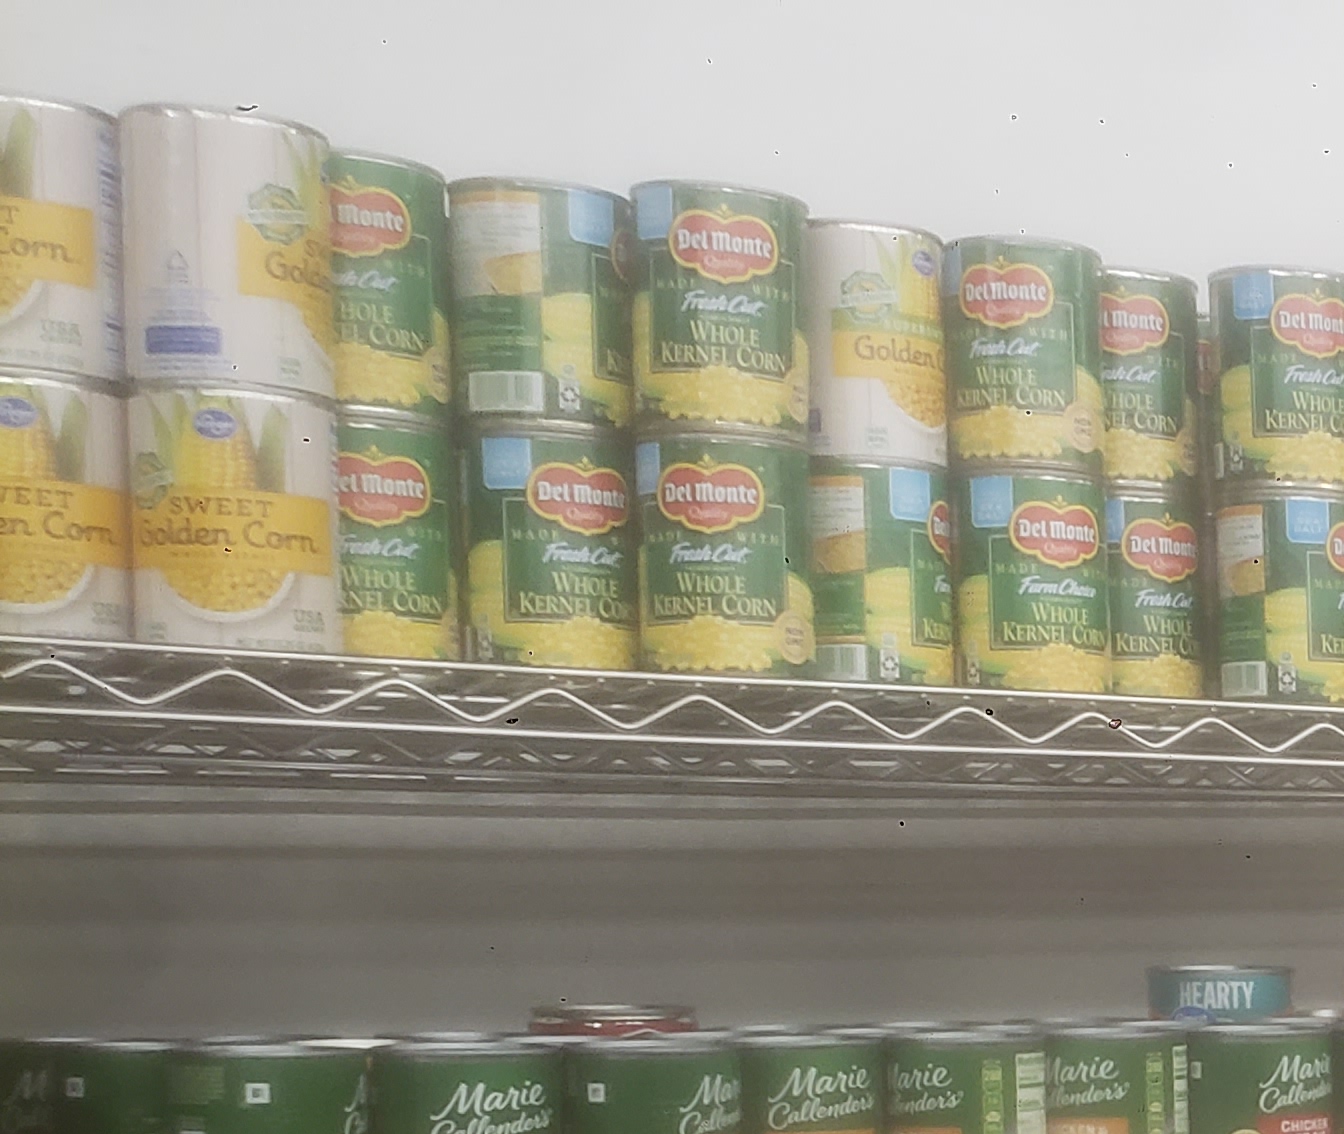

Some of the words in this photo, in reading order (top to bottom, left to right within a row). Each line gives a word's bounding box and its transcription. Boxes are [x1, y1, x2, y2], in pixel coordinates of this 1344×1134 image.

[677, 228, 709, 251] Del
[712, 231, 772, 259] Monte
[1279, 310, 1305, 328] Del
[690, 320, 760, 346] WHOLE
[661, 343, 732, 366] KERNEL
[735, 348, 787, 373] CORN
[855, 336, 935, 366] Golden
[1292, 391, 1344, 413] WHOLE
[1265, 409, 1326, 430] KERNEL
[362, 474, 425, 498] Monte
[537, 481, 566, 501] Del
[568, 484, 625, 508] Monte
[664, 481, 692, 501] Del
[694, 482, 757, 505] Monte
[169, 495, 274, 518] SWEET
[243, 520, 319, 553] Corn
[1019, 519, 1046, 539] Del
[1049, 520, 1095, 542] Monte
[1131, 535, 1156, 553] Del
[552, 572, 619, 596] WHOLE
[676, 572, 745, 595] WHOLE
[393, 593, 444, 614] CORN
[519, 593, 594, 616] KERNEL
[654, 593, 724, 616] KERNEL
[726, 595, 776, 616] CORN
[1031, 604, 1087, 624] WHOLE
[1003, 622, 1071, 643] KERNEL
[1116, 632, 1177, 652] KERNEL
[1179, 981, 1254, 1009] HEARTY
[768, 1065, 871, 1103] Marie
[429, 1080, 545, 1121] Marie
